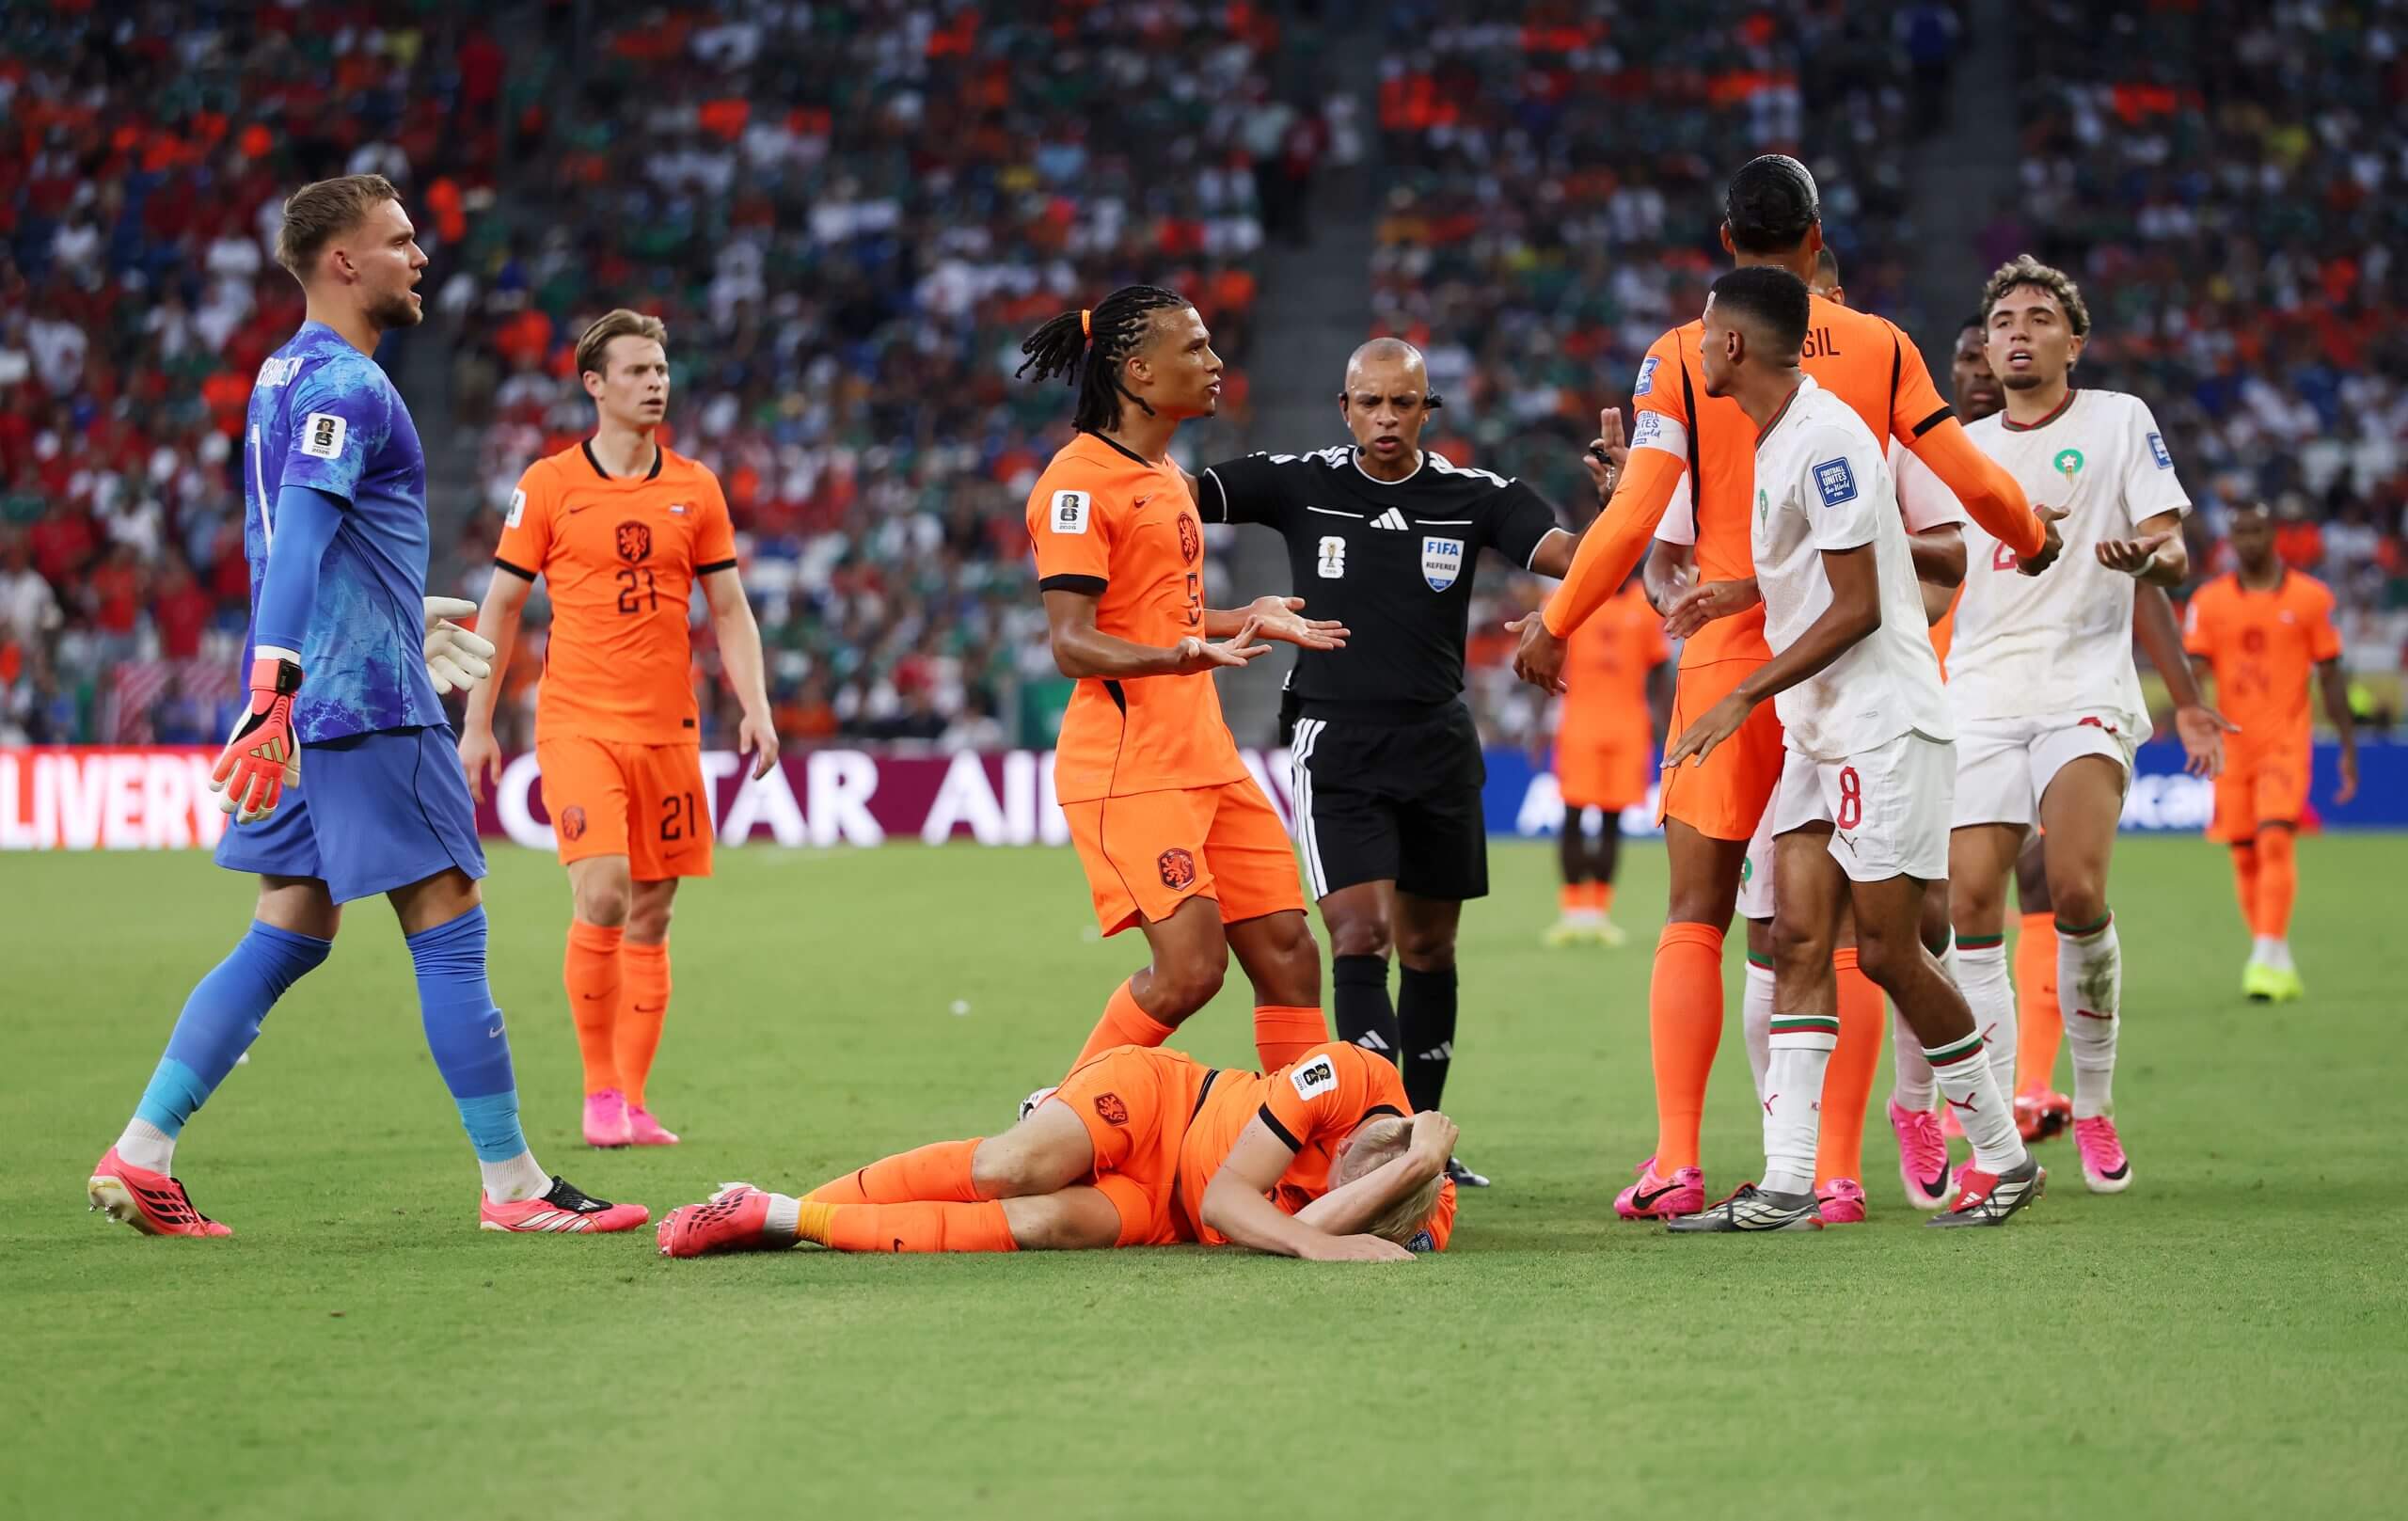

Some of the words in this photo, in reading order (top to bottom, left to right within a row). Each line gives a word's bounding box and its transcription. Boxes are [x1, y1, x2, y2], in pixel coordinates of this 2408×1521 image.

[1822, 471, 1847, 486] UNITES
[1427, 541, 1459, 556] FIFA
[1425, 561, 1457, 572] REFEREE
[616, 567, 657, 613] 21
[1836, 766, 1862, 831] 8
[660, 792, 696, 842] 21
